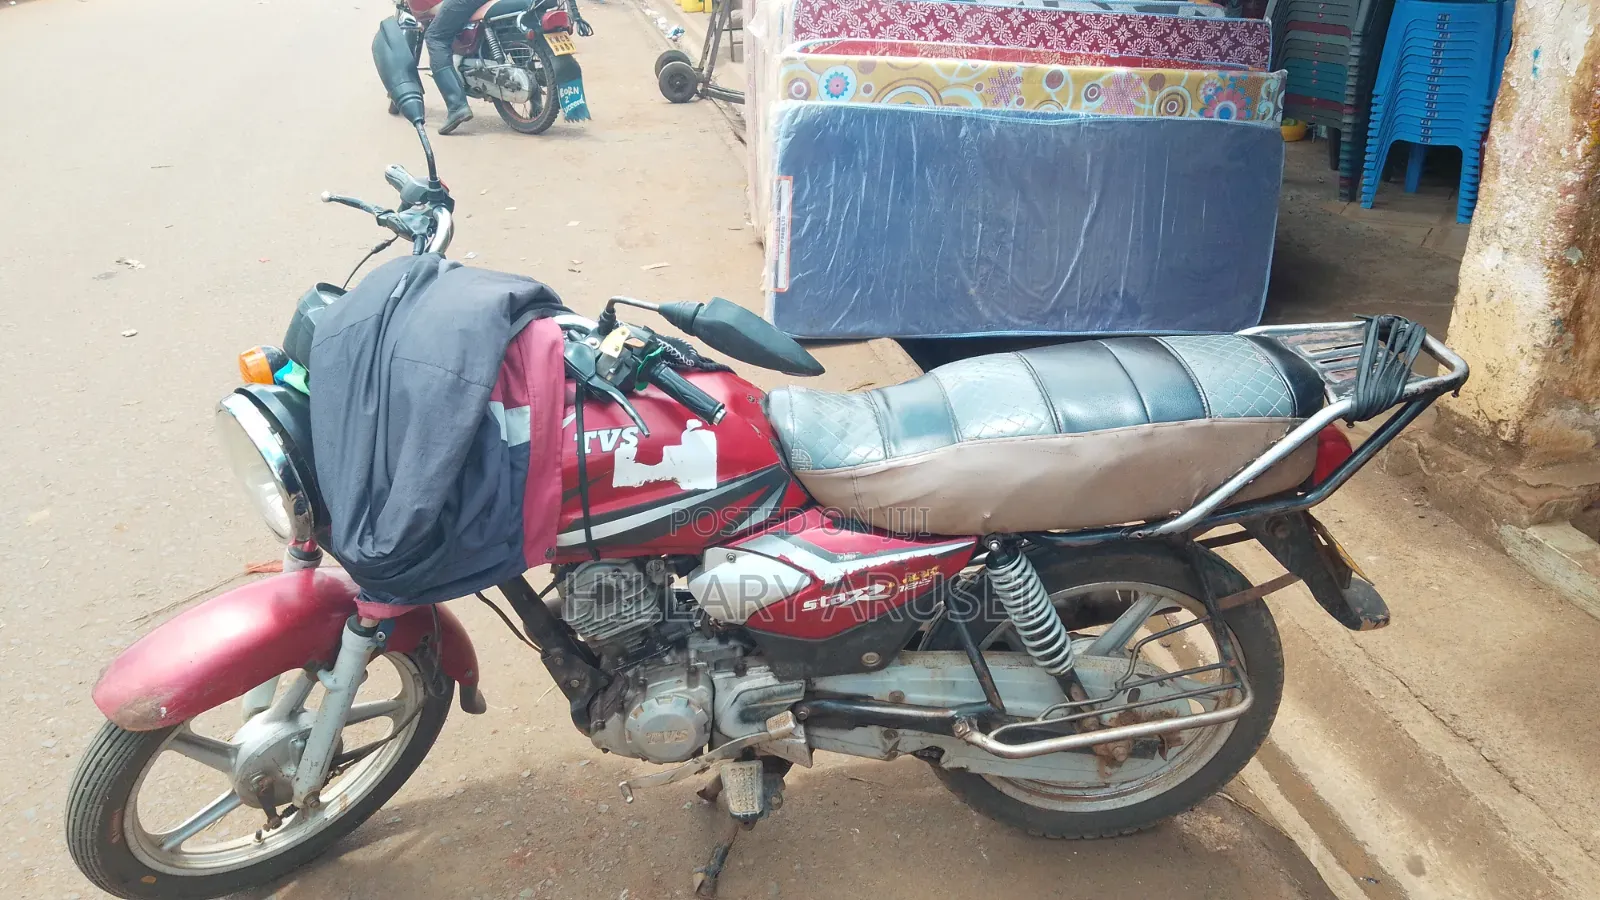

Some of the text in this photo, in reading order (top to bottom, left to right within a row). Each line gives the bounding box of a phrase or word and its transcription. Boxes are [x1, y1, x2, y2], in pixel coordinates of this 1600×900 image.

[559, 86, 580, 98] BORN
[564, 95, 570, 103] 2
[574, 426, 639, 454] TVS
[645, 730, 689, 744] TVS
